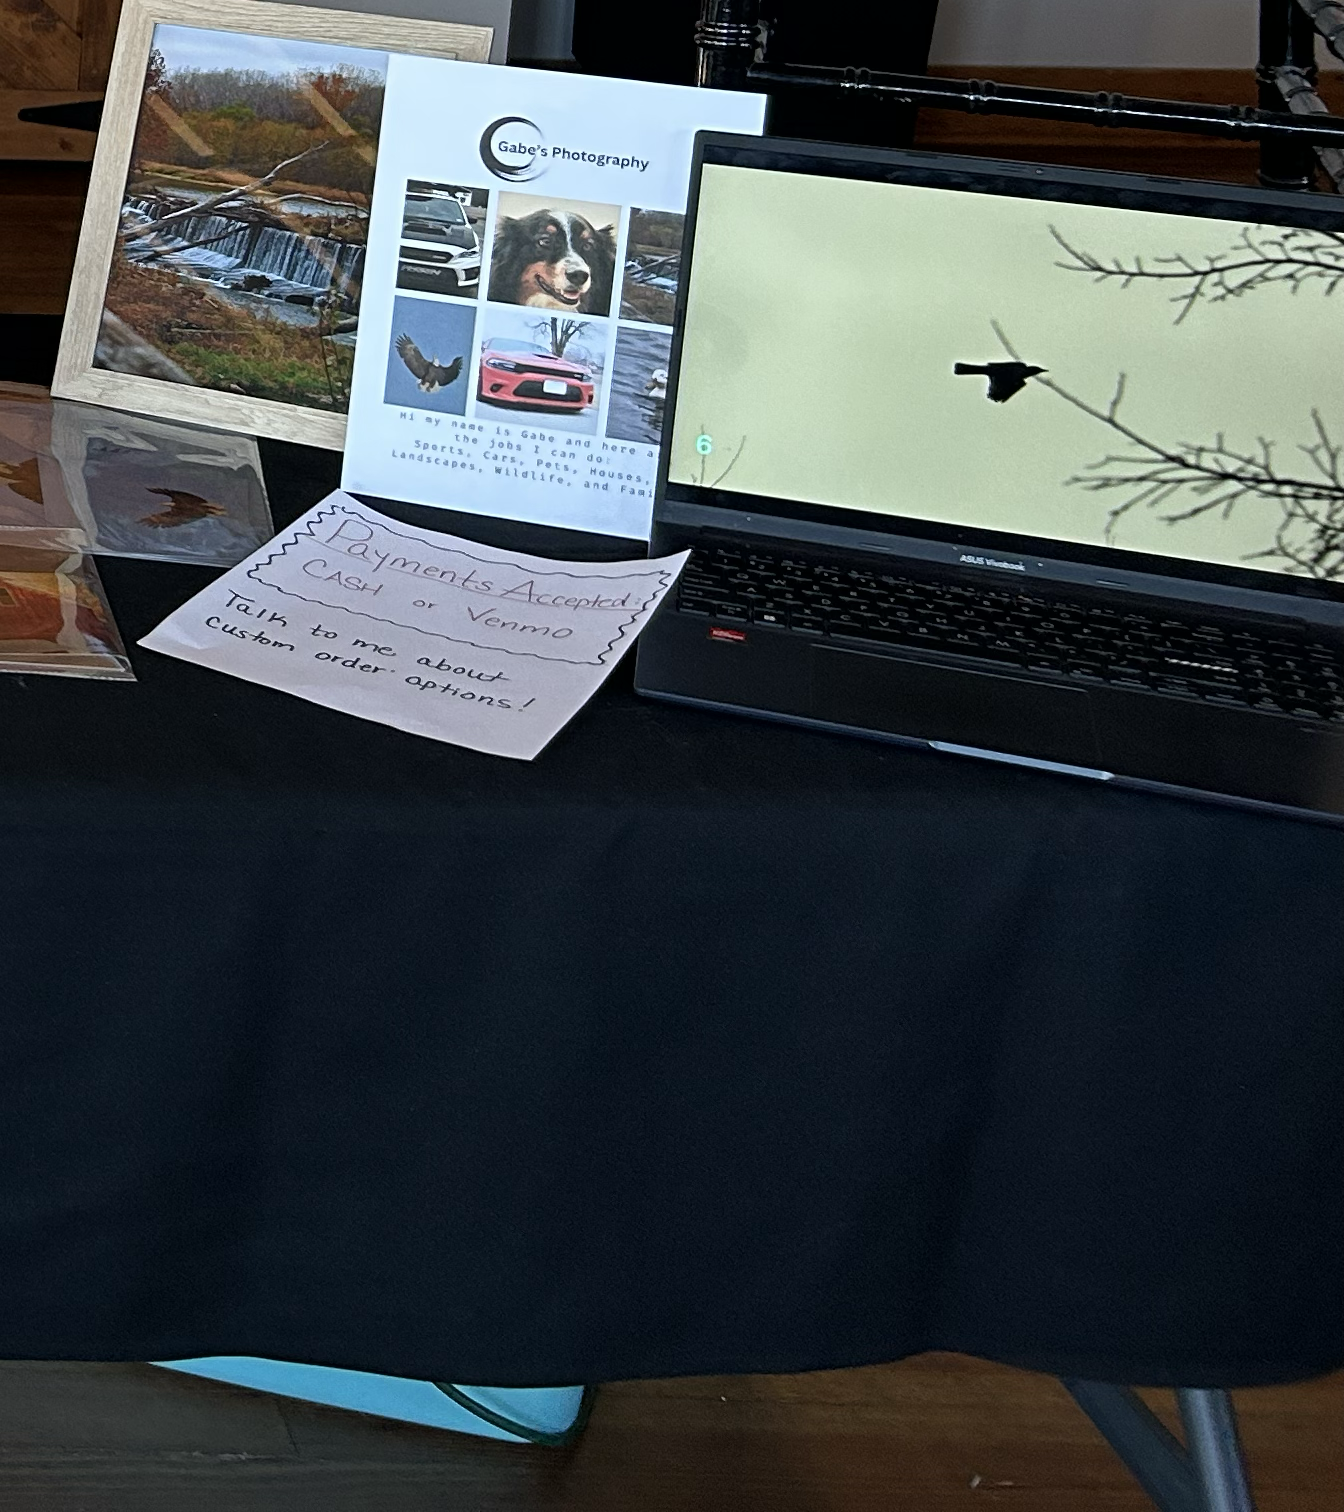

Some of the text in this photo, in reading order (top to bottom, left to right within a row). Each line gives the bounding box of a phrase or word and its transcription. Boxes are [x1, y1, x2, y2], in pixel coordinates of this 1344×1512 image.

[498, 140, 650, 173] Gabe's Photography
[399, 412, 414, 421] Hi
[425, 416, 441, 426] my
[451, 420, 484, 432] name
[496, 426, 510, 436] is
[521, 430, 555, 443] Gabe
[565, 438, 591, 449] and
[601, 442, 636, 455] here
[454, 434, 478, 444] the
[489, 438, 522, 452] jobs
[533, 444, 540, 455] I
[551, 449, 576, 459] can
[584, 481, 609, 491] and
[325, 519, 494, 592] Payments
[960, 554, 985, 565] ASUS
[303, 559, 574, 639] CASH or Venmo
[225, 589, 512, 682] Talk to me about
